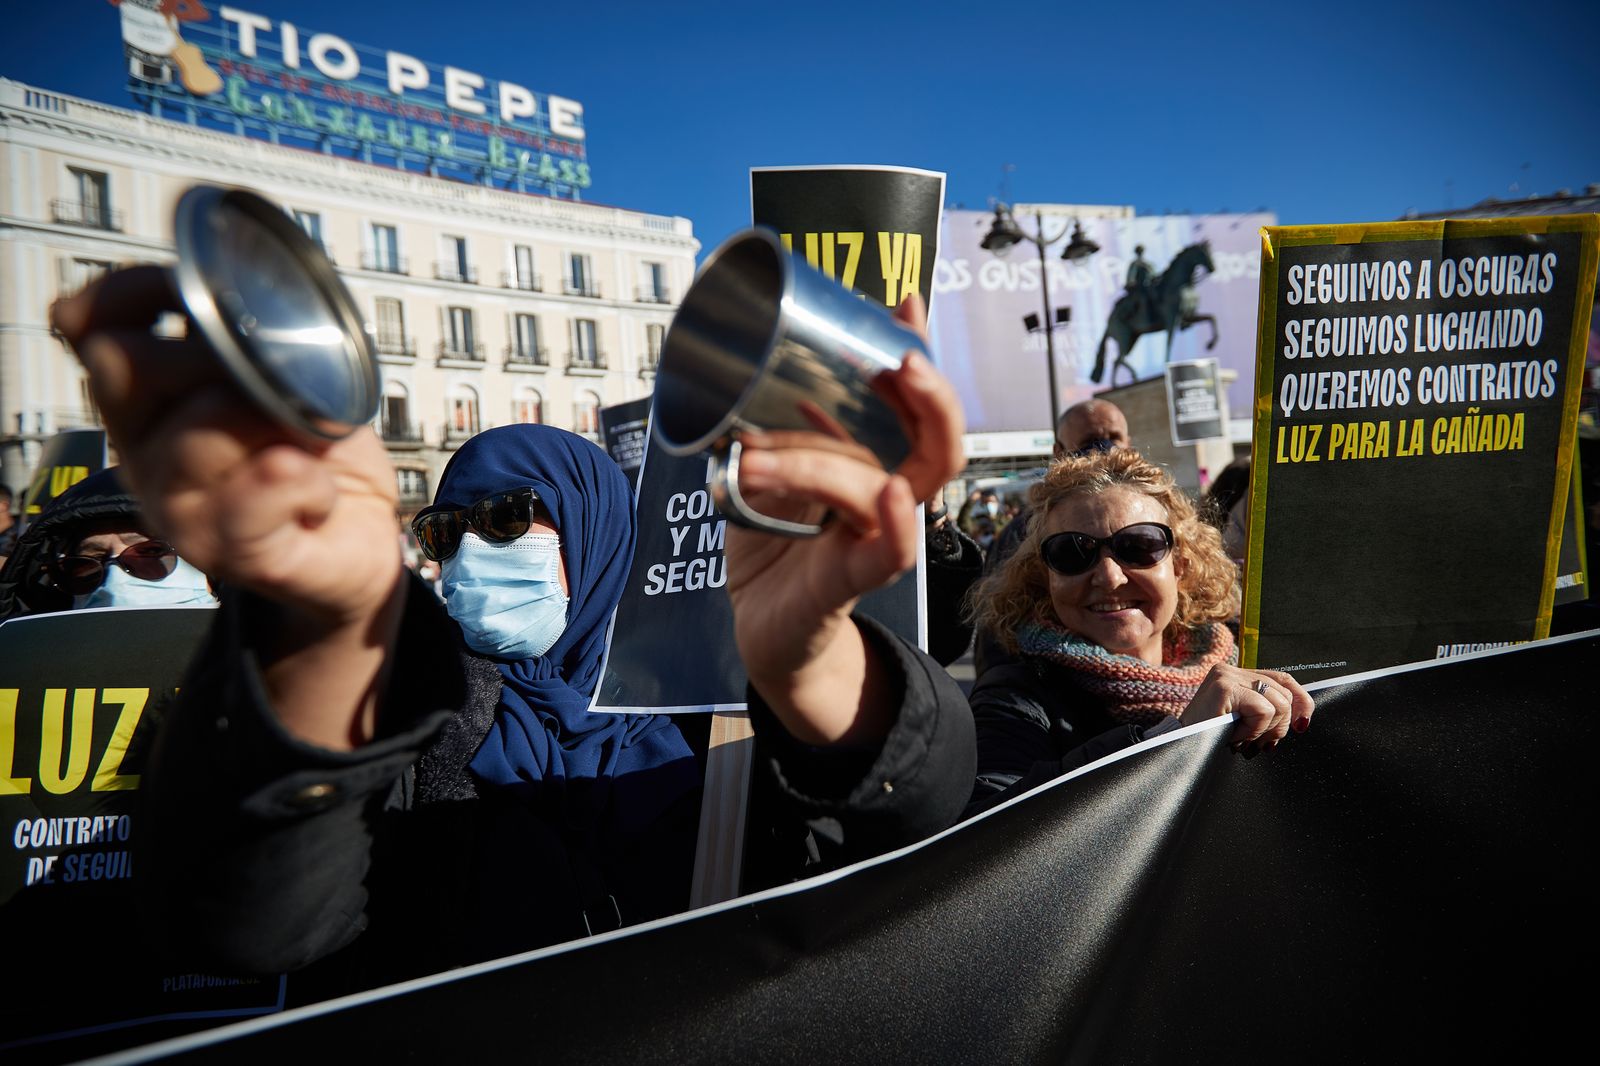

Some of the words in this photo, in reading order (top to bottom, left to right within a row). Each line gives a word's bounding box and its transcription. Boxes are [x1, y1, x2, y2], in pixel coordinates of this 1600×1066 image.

[219, 5, 361, 82] TIO
[386, 50, 586, 140] PEPE
[877, 231, 922, 307] YA
[1287, 260, 1412, 306] SEGUIMOS
[1416, 260, 1431, 299] A
[1438, 252, 1557, 299] OSCURAS
[1284, 314, 1408, 360] SEGUIMOS
[1414, 307, 1543, 353] LUCHANDO
[1280, 367, 1411, 417] QUEREMOS
[1417, 359, 1558, 405] CONTRATOS
[1276, 424, 1323, 464] LUZ
[1328, 420, 1390, 461] PARA
[1396, 418, 1425, 457] LA
[1431, 406, 1526, 455] CAÑADA
[669, 525, 691, 557] Y
[697, 520, 727, 553] M
[643, 555, 727, 596] SEGU
[0, 687, 149, 795] LUZ
[13, 814, 131, 849] CONTRATO
[25, 855, 59, 888] DE
